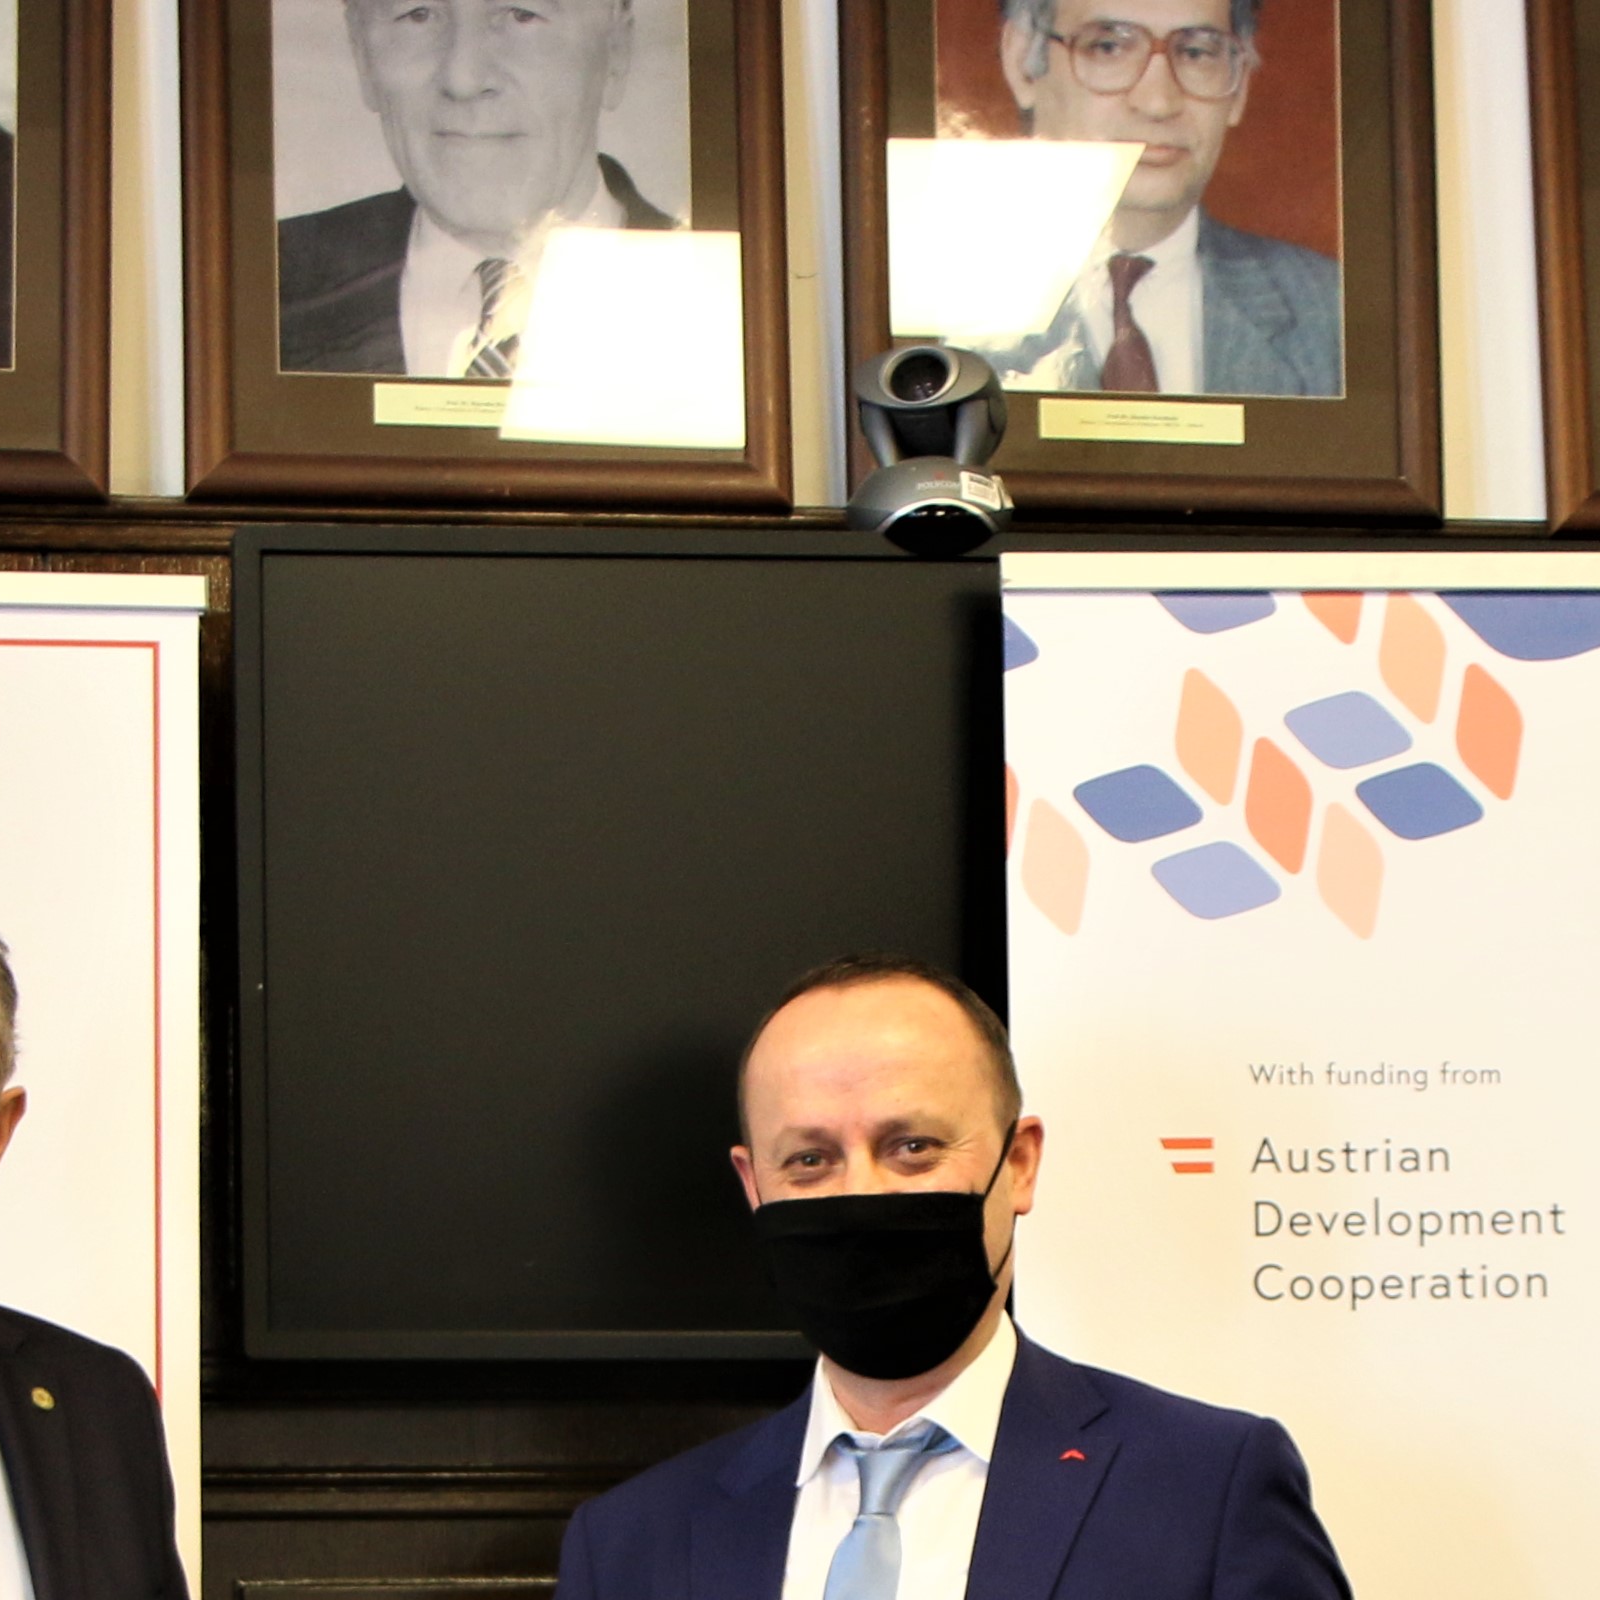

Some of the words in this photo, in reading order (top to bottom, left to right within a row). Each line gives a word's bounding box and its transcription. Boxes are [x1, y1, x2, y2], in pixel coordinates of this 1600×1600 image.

[1248, 1062, 1314, 1087] With
[1326, 1062, 1428, 1092] funding
[1439, 1061, 1502, 1086] from
[1250, 1136, 1452, 1174] Austrian
[1253, 1197, 1567, 1247] Development
[1252, 1262, 1550, 1312] Cooperation
